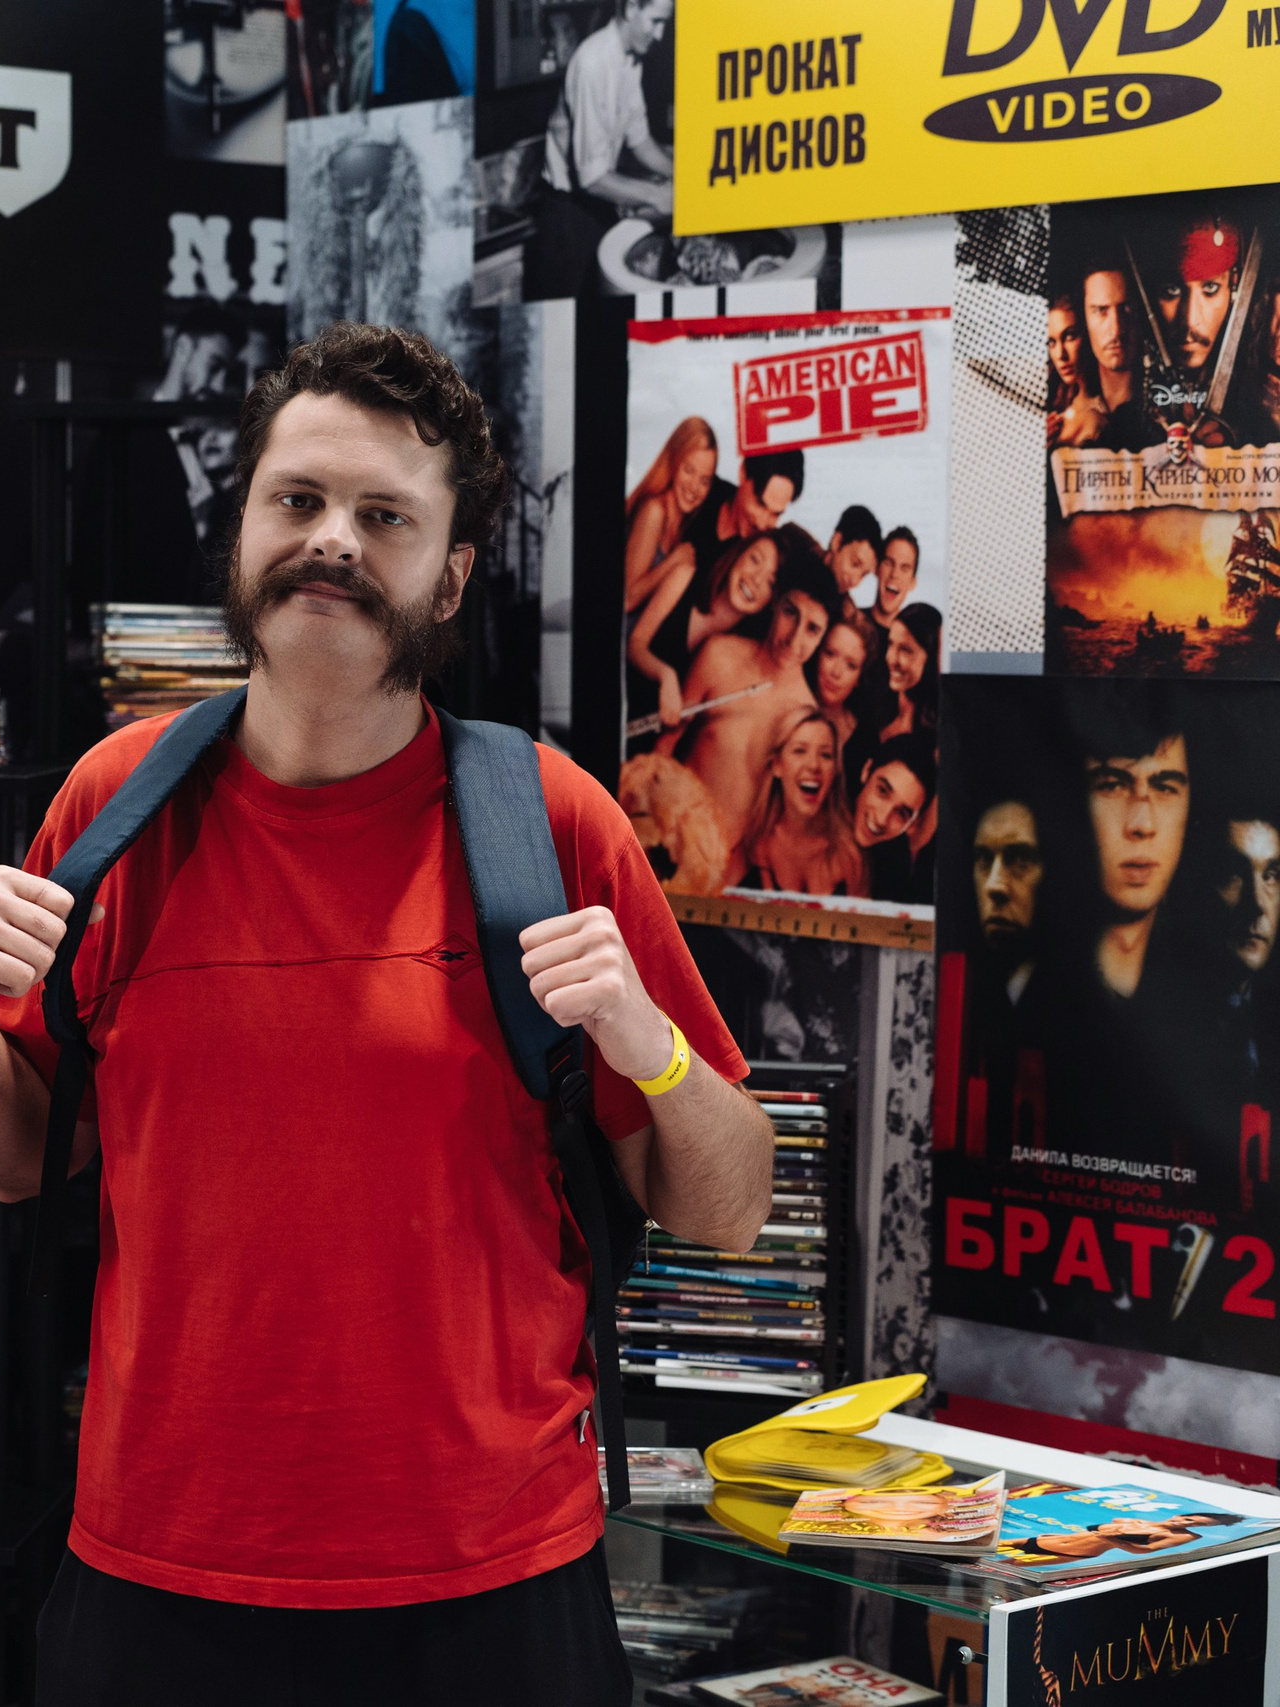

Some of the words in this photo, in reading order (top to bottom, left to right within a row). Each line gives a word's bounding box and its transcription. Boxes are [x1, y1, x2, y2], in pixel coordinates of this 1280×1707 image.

[942, 0, 1227, 77] DVD
[716, 34, 862, 102] ПРОКАТ
[986, 83, 1152, 133] VIDEO
[708, 113, 867, 187] ДИСКОВ
[744, 342, 916, 399] AMERICAN
[745, 377, 919, 447] PIE
[1011, 1145, 1068, 1166] ДАНИЛА
[1071, 1153, 1198, 1184] ВОЗВРАЩАЕТСЯ!
[1042, 1169, 1096, 1189] СЕРГЕЙ
[1099, 1176, 1162, 1199] БОДРОВ
[1047, 1190, 1111, 1211] АЛЕКСЕЯ
[1115, 1200, 1218, 1226] БАЛАБАНОВА
[945, 1196, 1170, 1299] БРАТ
[1222, 1234, 1277, 1319] 2
[1147, 1606, 1169, 1621] THE
[829, 1662, 909, 1697] ОНА
[1071, 1613, 1239, 1692] MUMMY
